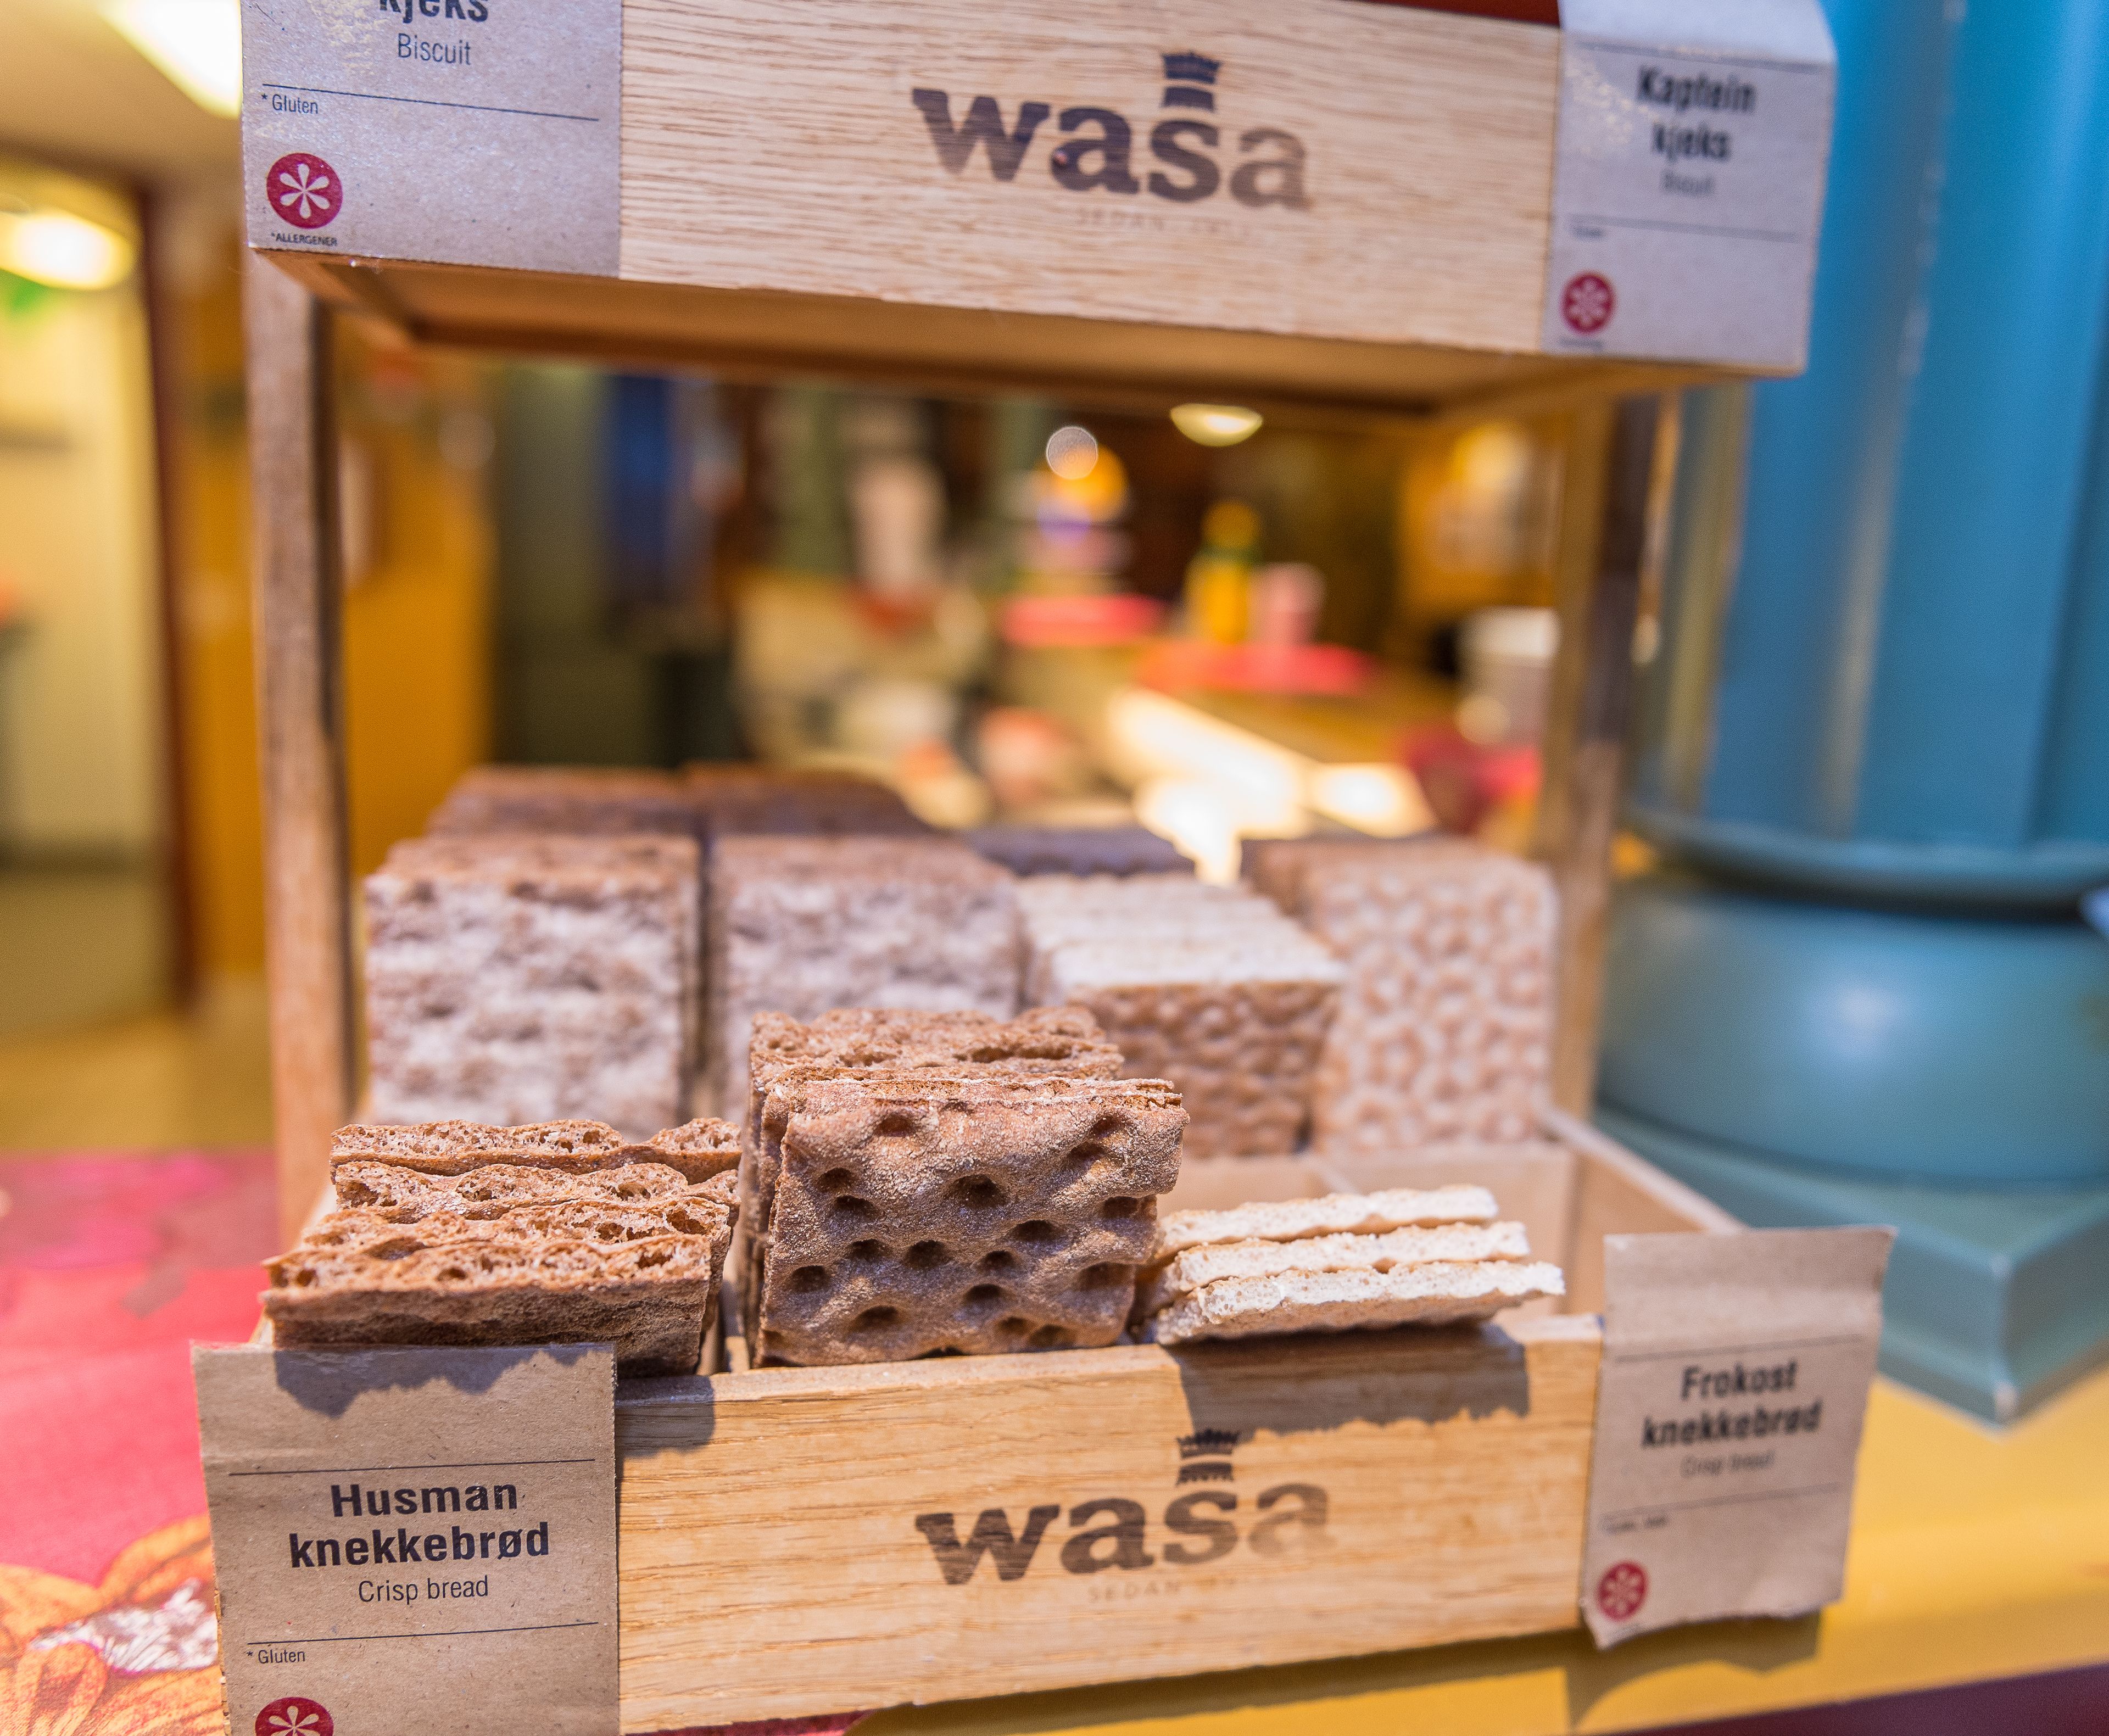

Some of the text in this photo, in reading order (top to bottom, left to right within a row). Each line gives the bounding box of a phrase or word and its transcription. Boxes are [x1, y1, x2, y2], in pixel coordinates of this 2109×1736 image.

[398, 33, 471, 65] Biscuit
[272, 94, 319, 114] Gluten
[1638, 64, 1756, 113] Kaptein
[912, 87, 1314, 211] wasa
[1681, 1358, 1798, 1401] Frokost
[1642, 1398, 1823, 1449] knekkebrød
[331, 1483, 517, 1517] Husman
[289, 1521, 550, 1568] knekkebrød
[915, 1482, 1338, 1585] wasa
[358, 1575, 489, 1605] Crisp bread
[258, 1649, 306, 1665] Gluten
